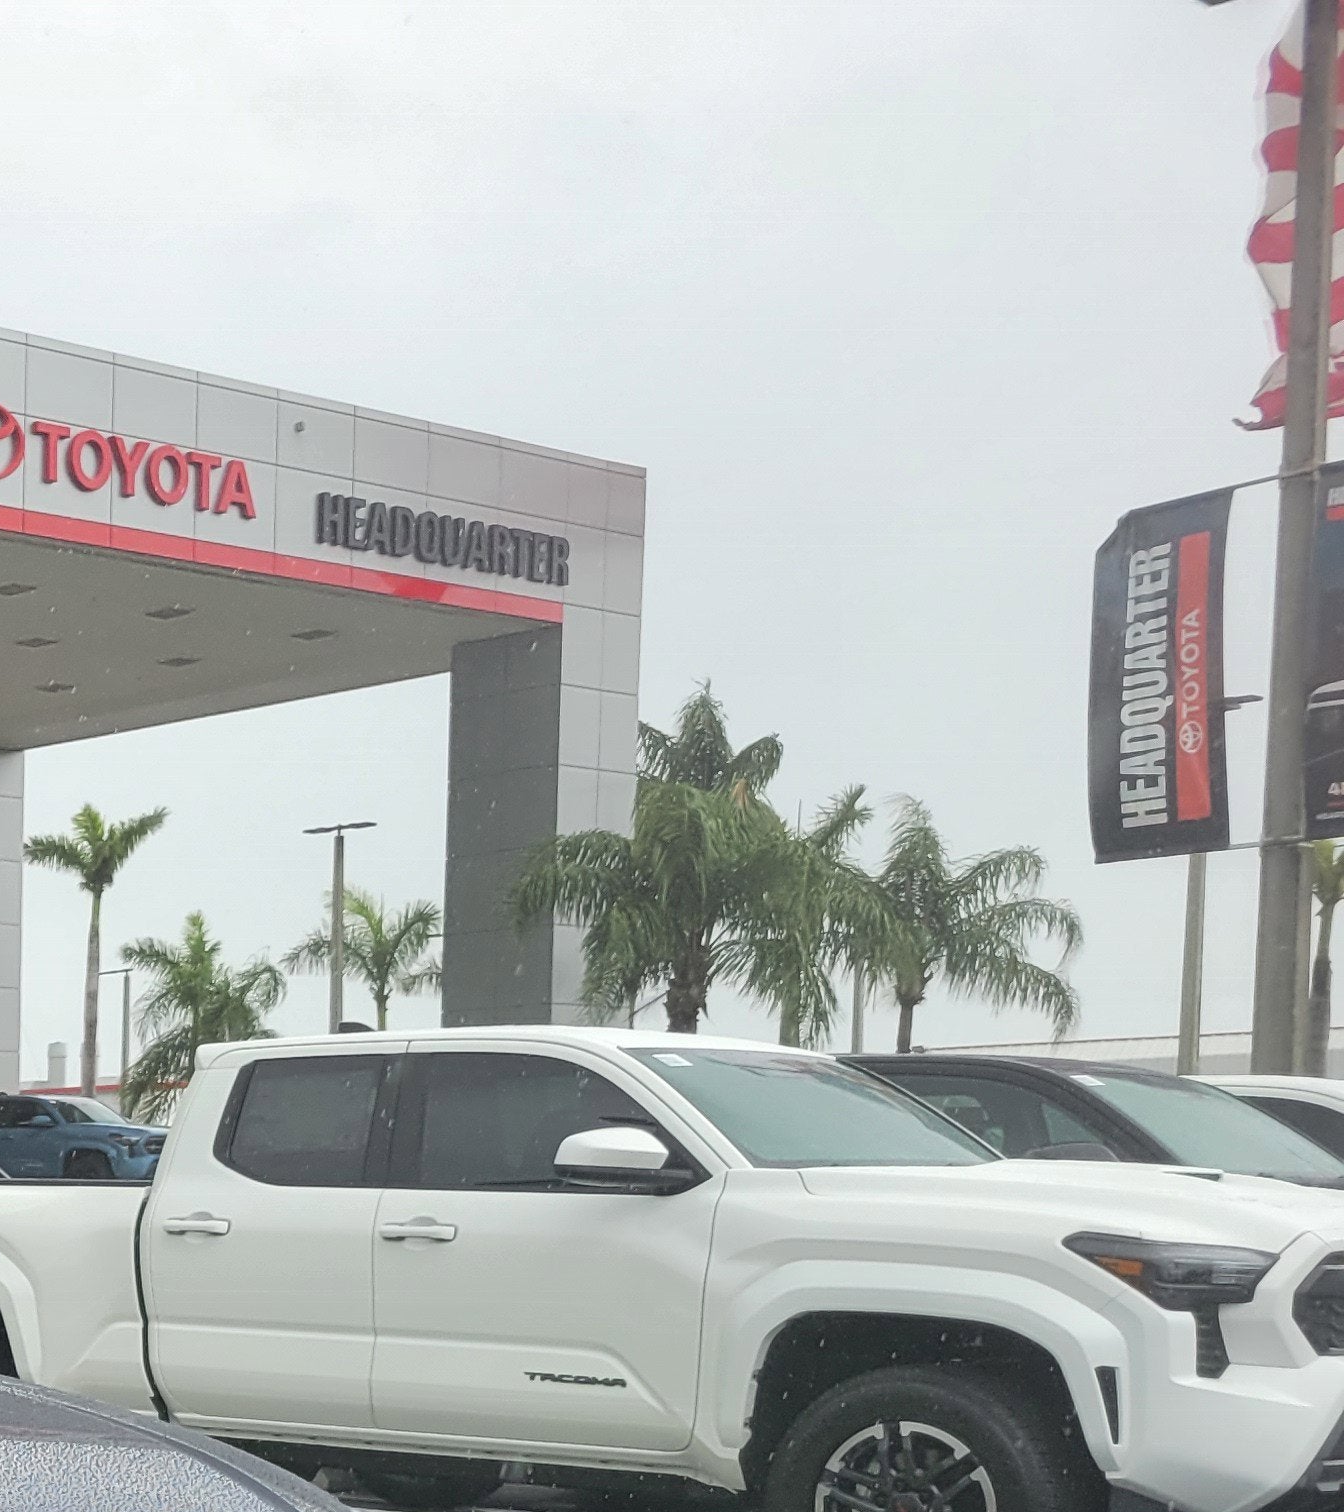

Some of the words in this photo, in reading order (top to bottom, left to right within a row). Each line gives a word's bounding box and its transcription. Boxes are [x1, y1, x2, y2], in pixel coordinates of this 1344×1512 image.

[31, 420, 257, 520] TOYOTA
[316, 491, 570, 587] HEADQUARTER
[1119, 541, 1173, 829] HEADQUARTER
[1180, 609, 1201, 719] TOYOTA
[524, 1371, 627, 1388] TACOMA
